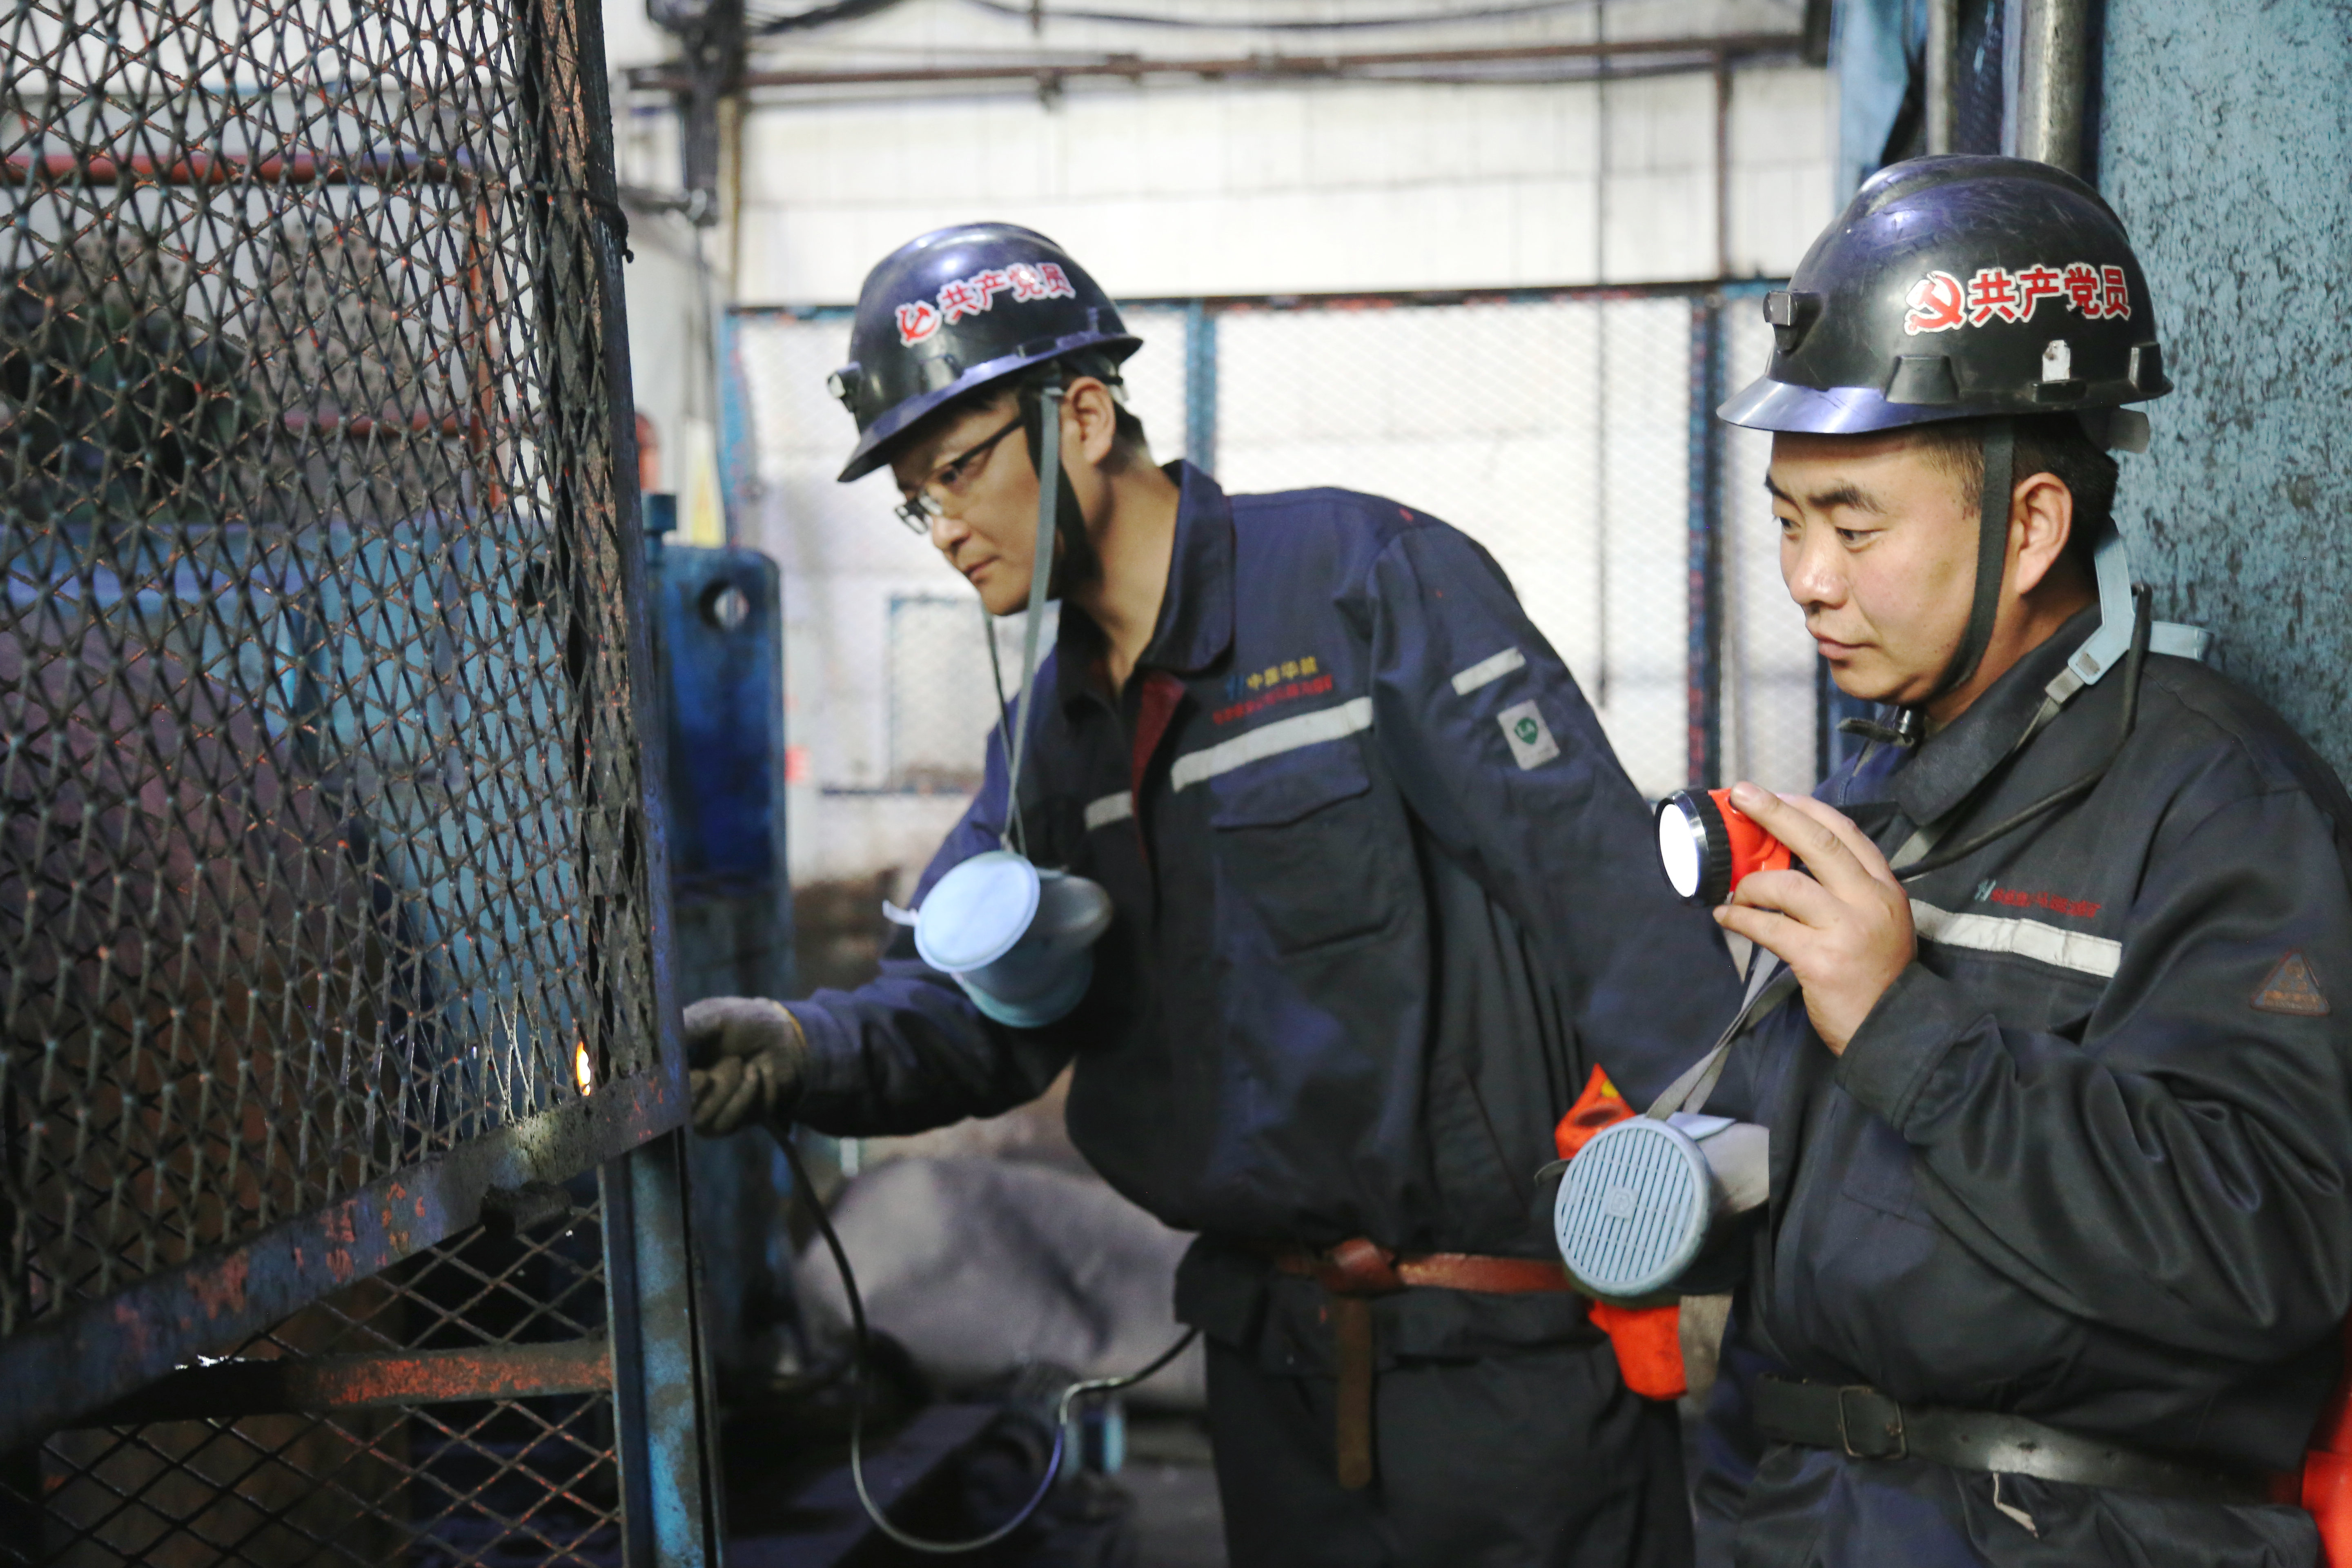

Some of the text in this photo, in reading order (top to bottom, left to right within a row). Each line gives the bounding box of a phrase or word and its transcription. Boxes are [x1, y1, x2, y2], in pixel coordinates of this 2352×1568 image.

[939, 263, 1074, 323] 共产党员
[1970, 264, 2130, 325] 共产党员
